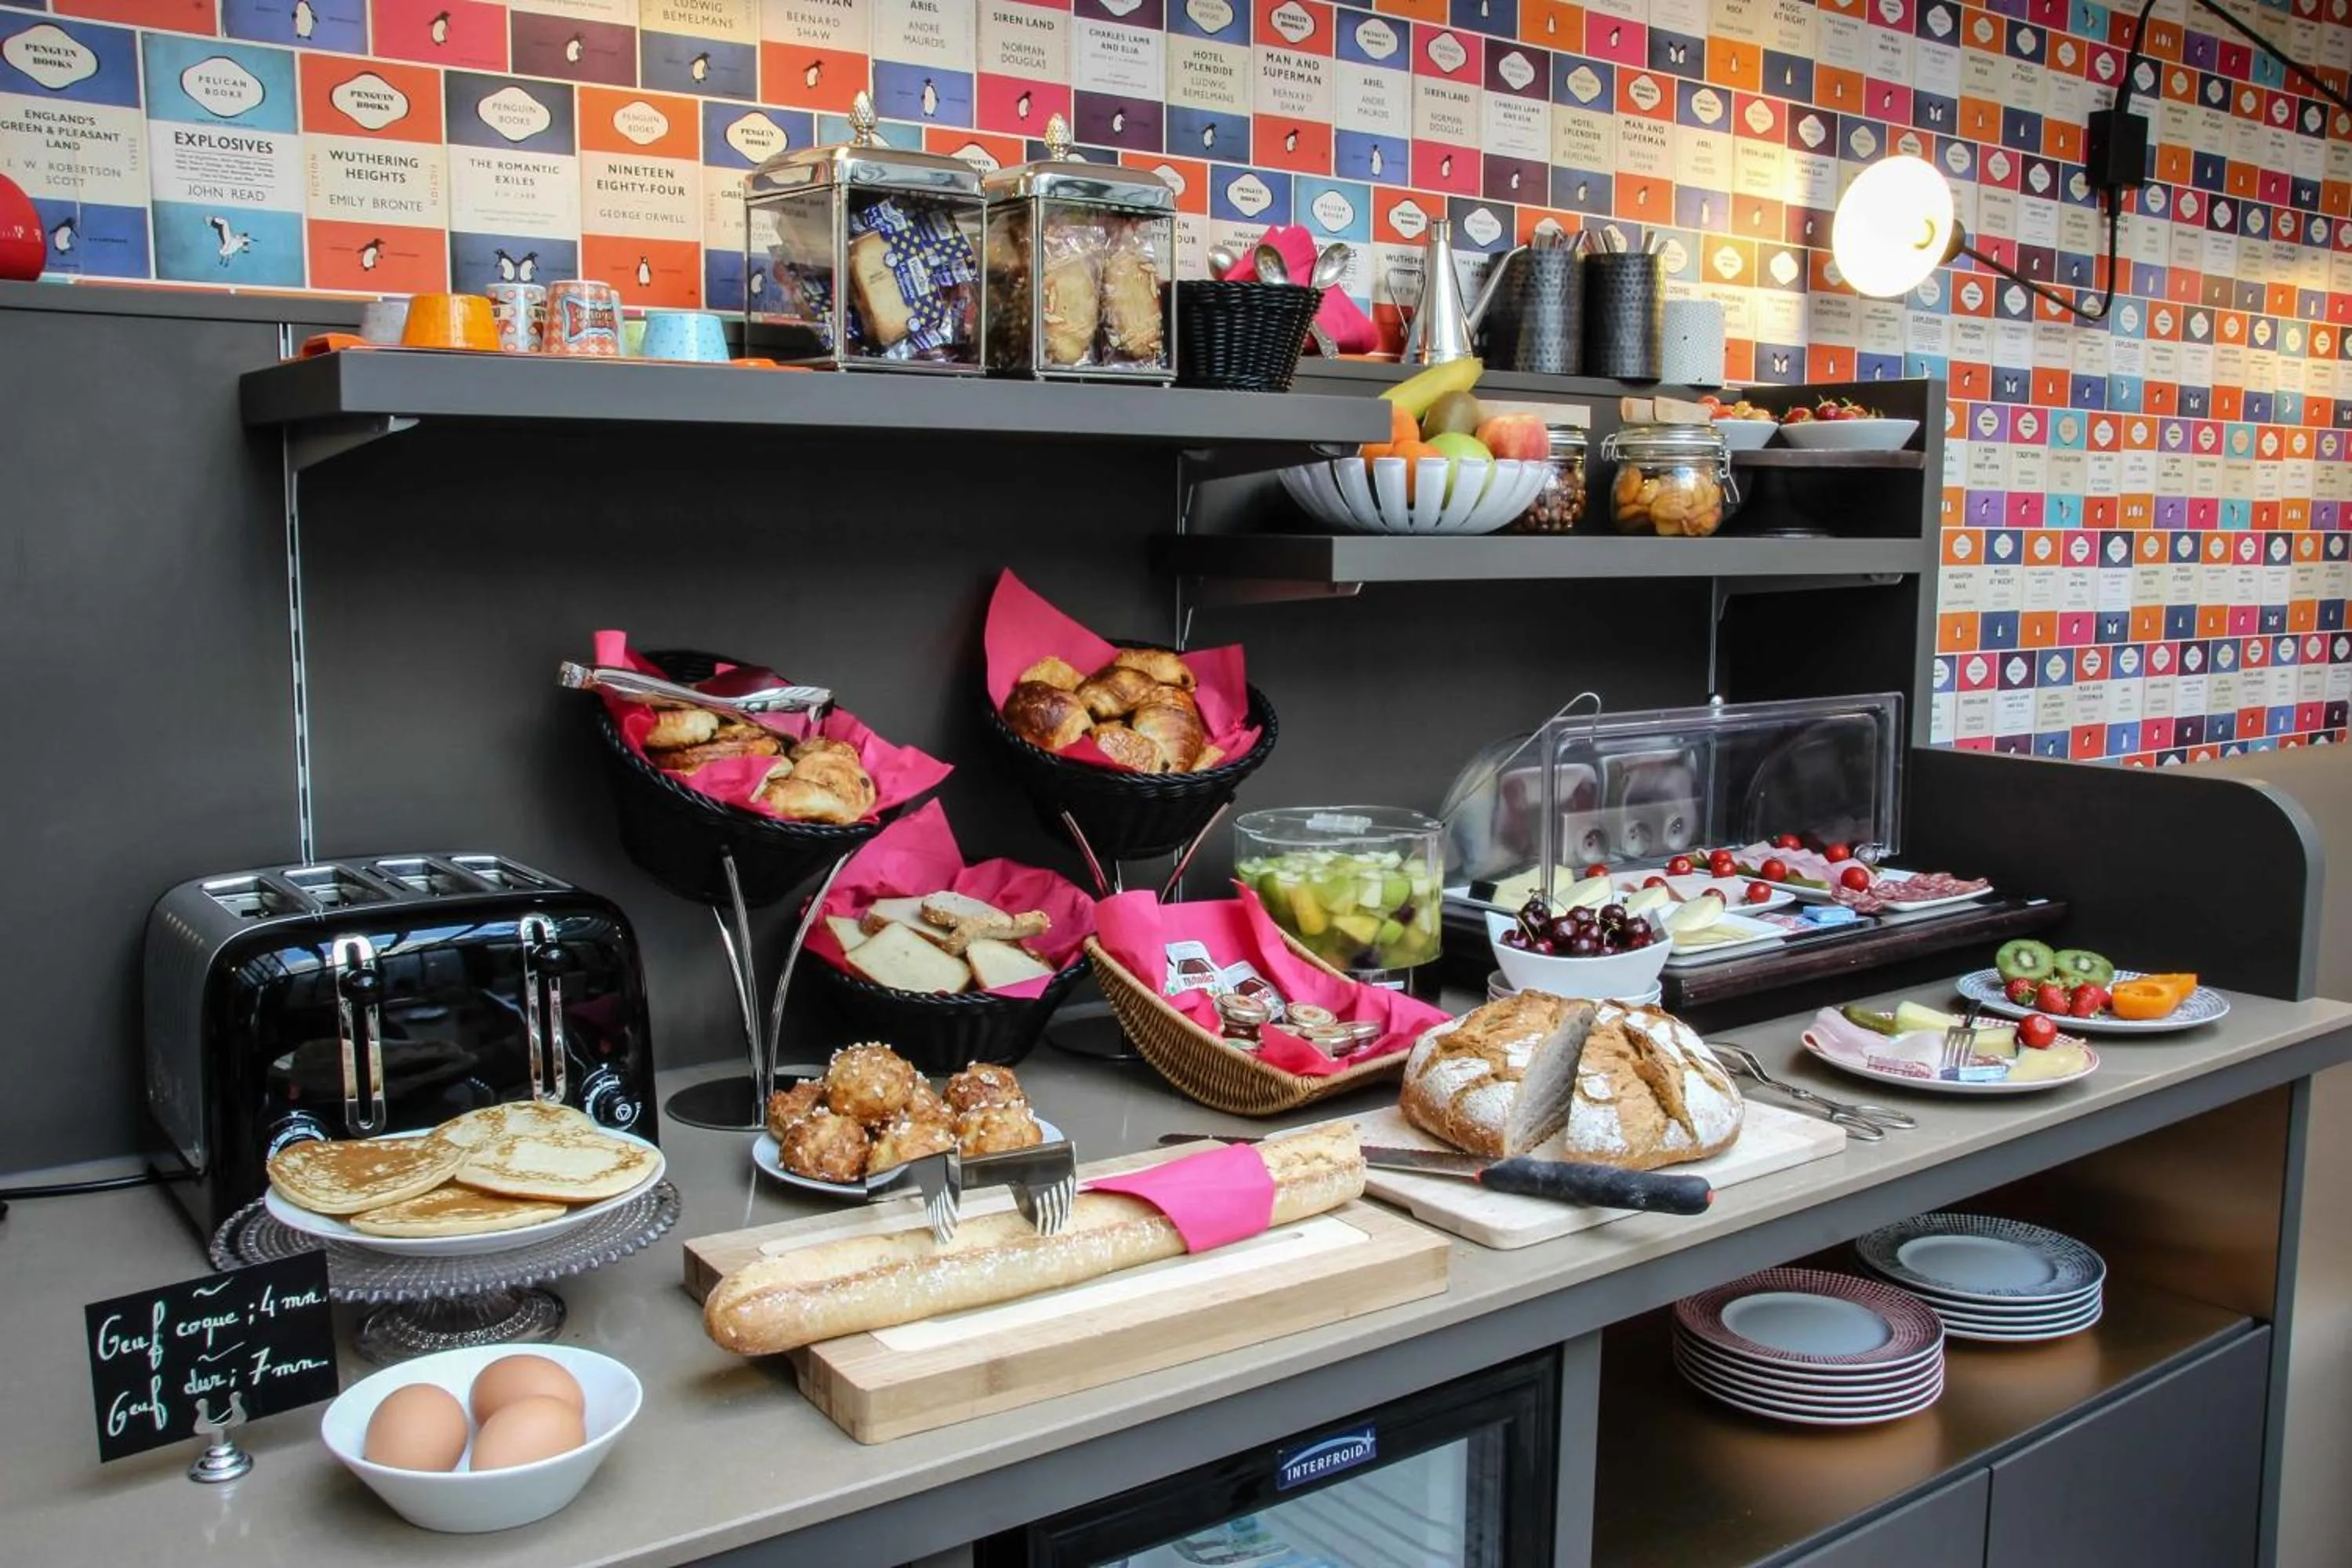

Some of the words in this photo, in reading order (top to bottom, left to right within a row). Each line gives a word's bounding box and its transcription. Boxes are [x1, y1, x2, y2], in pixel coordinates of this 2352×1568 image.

[910, 0, 938, 13] ARIEL
[662, 10, 734, 28] BEMELMANS
[786, 11, 840, 27] BERNARD
[993, 12, 1023, 25] SIREN
[1025, 16, 1054, 31] LAND
[796, 28, 830, 40] SHAW
[25, 43, 77, 57] PENGUIN
[1000, 41, 1045, 56] NORMAN
[1101, 42, 1119, 52] AND
[33, 57, 73, 68] BOOKS
[1000, 53, 1046, 69] DOUGLAS
[1193, 50, 1224, 63] HOTEL
[1266, 52, 1291, 65] MAN
[1296, 59, 1319, 71] AND
[1183, 60, 1233, 77] SPLENDIDE
[1263, 65, 1321, 85] SUPERMAN
[198, 74, 247, 88] PELICAN
[1191, 77, 1226, 90] LUDWIG
[1363, 78, 1385, 89] ARIEL
[205, 87, 242, 98] BOOKS
[350, 90, 395, 101] PENGUIN
[1183, 87, 1234, 103] BEMELMANS
[1272, 88, 1312, 103] BERNARD
[1448, 92, 1470, 103] LAND
[357, 101, 390, 111] BOOKS
[492, 102, 536, 114] PENGUIN
[24, 109, 96, 125] ENGLAND'S
[499, 115, 531, 126] BOOKS
[1, 121, 42, 133] GREEN
[46, 127, 54, 136] &
[58, 127, 120, 143] PLEASANT
[1624, 118, 1644, 130] MAN
[1646, 125, 1664, 135] AND
[46, 140, 81, 151] LAND
[175, 131, 274, 154] EXPLOSIVES
[1622, 131, 1667, 147] SUPERMAN
[329, 150, 419, 169] WUTHERING
[470, 158, 492, 169] THE
[497, 162, 560, 175] ROMANTIC
[48, 162, 121, 178] ROBERTSON
[346, 168, 406, 184] HEIGHTS
[608, 164, 674, 179] NINETEEN
[45, 175, 85, 187] SCOTT
[495, 175, 535, 187] EXILES
[597, 180, 685, 197] EIGHTY-FOUR
[187, 183, 223, 198] JOHN
[231, 188, 266, 201] READ
[329, 194, 365, 208] EMILY
[600, 208, 641, 221] GEORGE
[645, 212, 685, 223] ORWELL
[1287, 1443, 1364, 1481] INTERFROID
